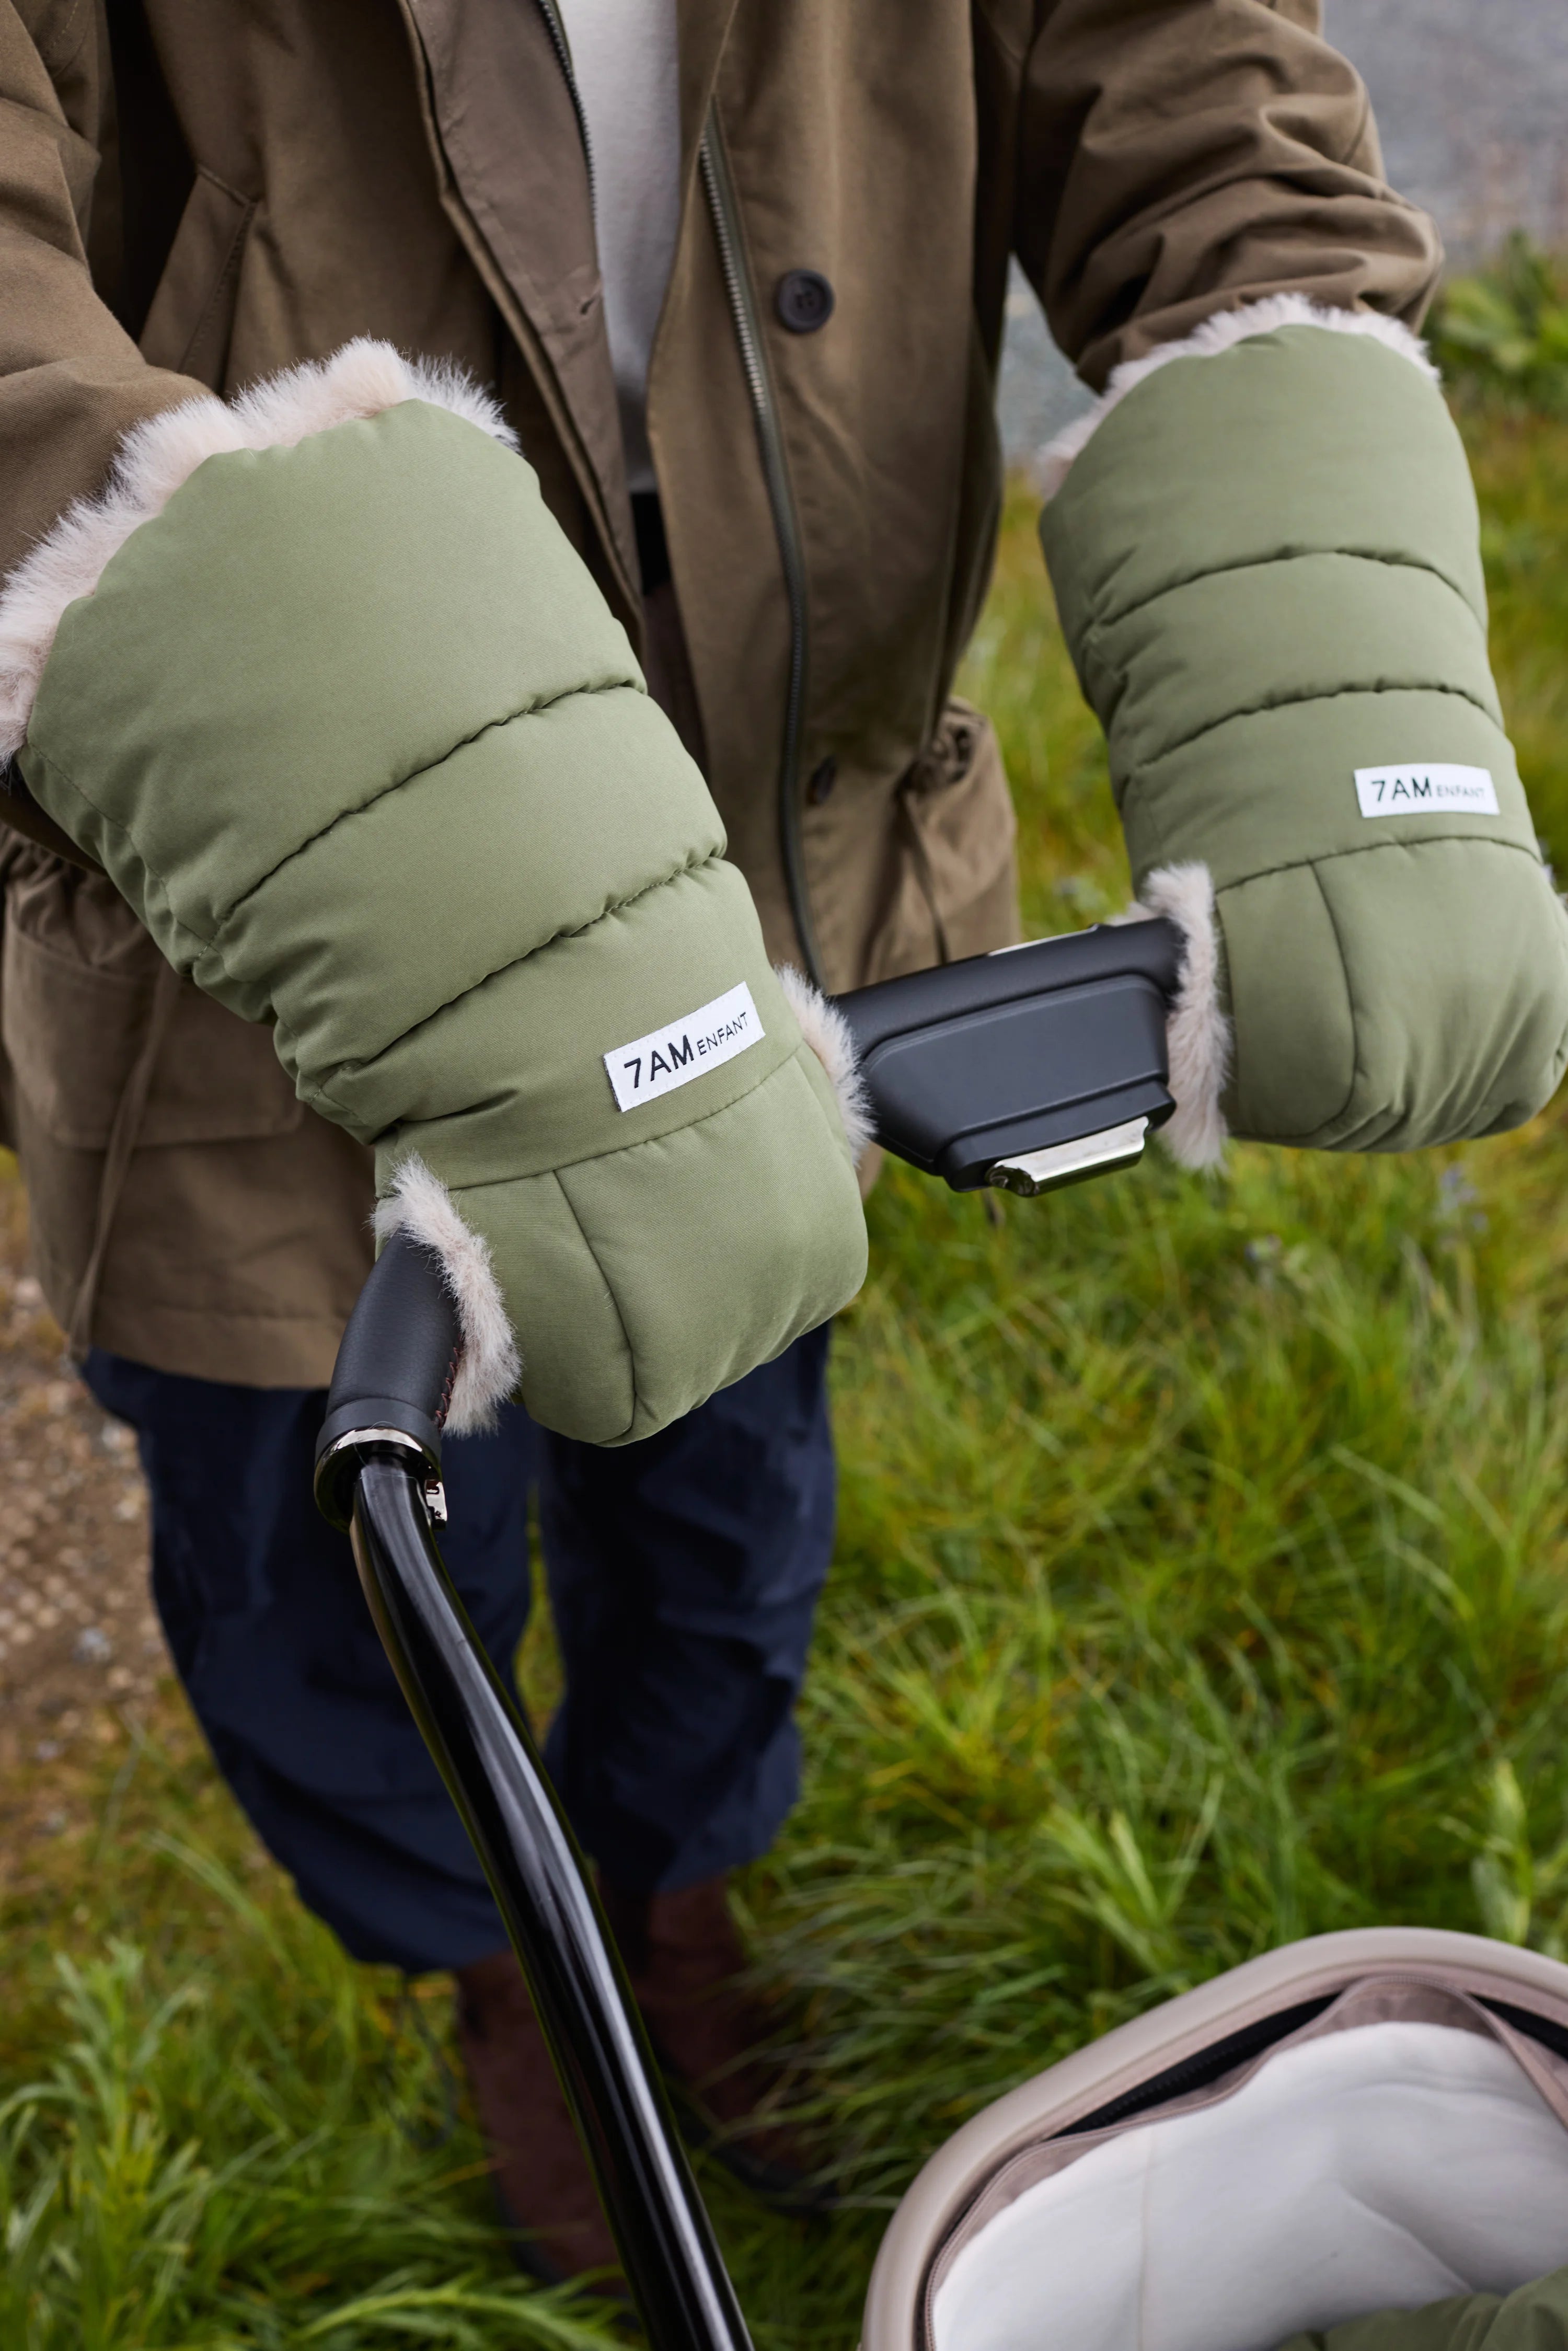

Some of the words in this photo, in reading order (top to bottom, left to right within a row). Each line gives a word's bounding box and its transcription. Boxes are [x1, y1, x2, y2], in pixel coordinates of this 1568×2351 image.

[1371, 776, 1432, 802] 7AM
[1436, 785, 1484, 798] ENFANT
[624, 1034, 694, 1089] 7AM
[697, 1012, 748, 1056] ENFANT
